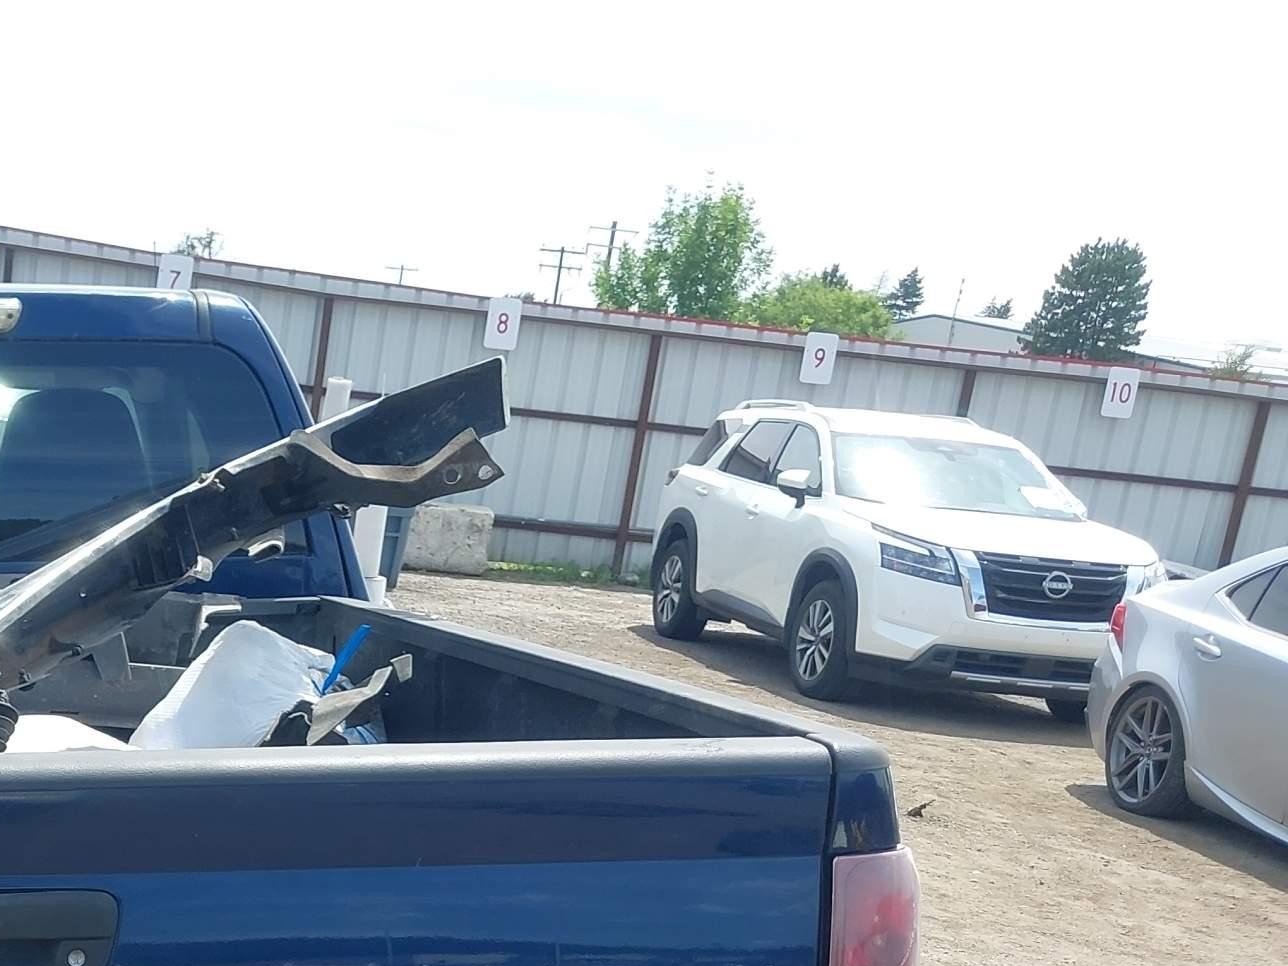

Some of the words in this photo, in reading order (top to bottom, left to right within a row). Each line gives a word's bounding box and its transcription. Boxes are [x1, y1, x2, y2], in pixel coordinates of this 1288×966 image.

[169, 269, 181, 288] 7
[496, 313, 509, 334] 8
[814, 347, 826, 369] 9
[1110, 381, 1132, 403] 10
